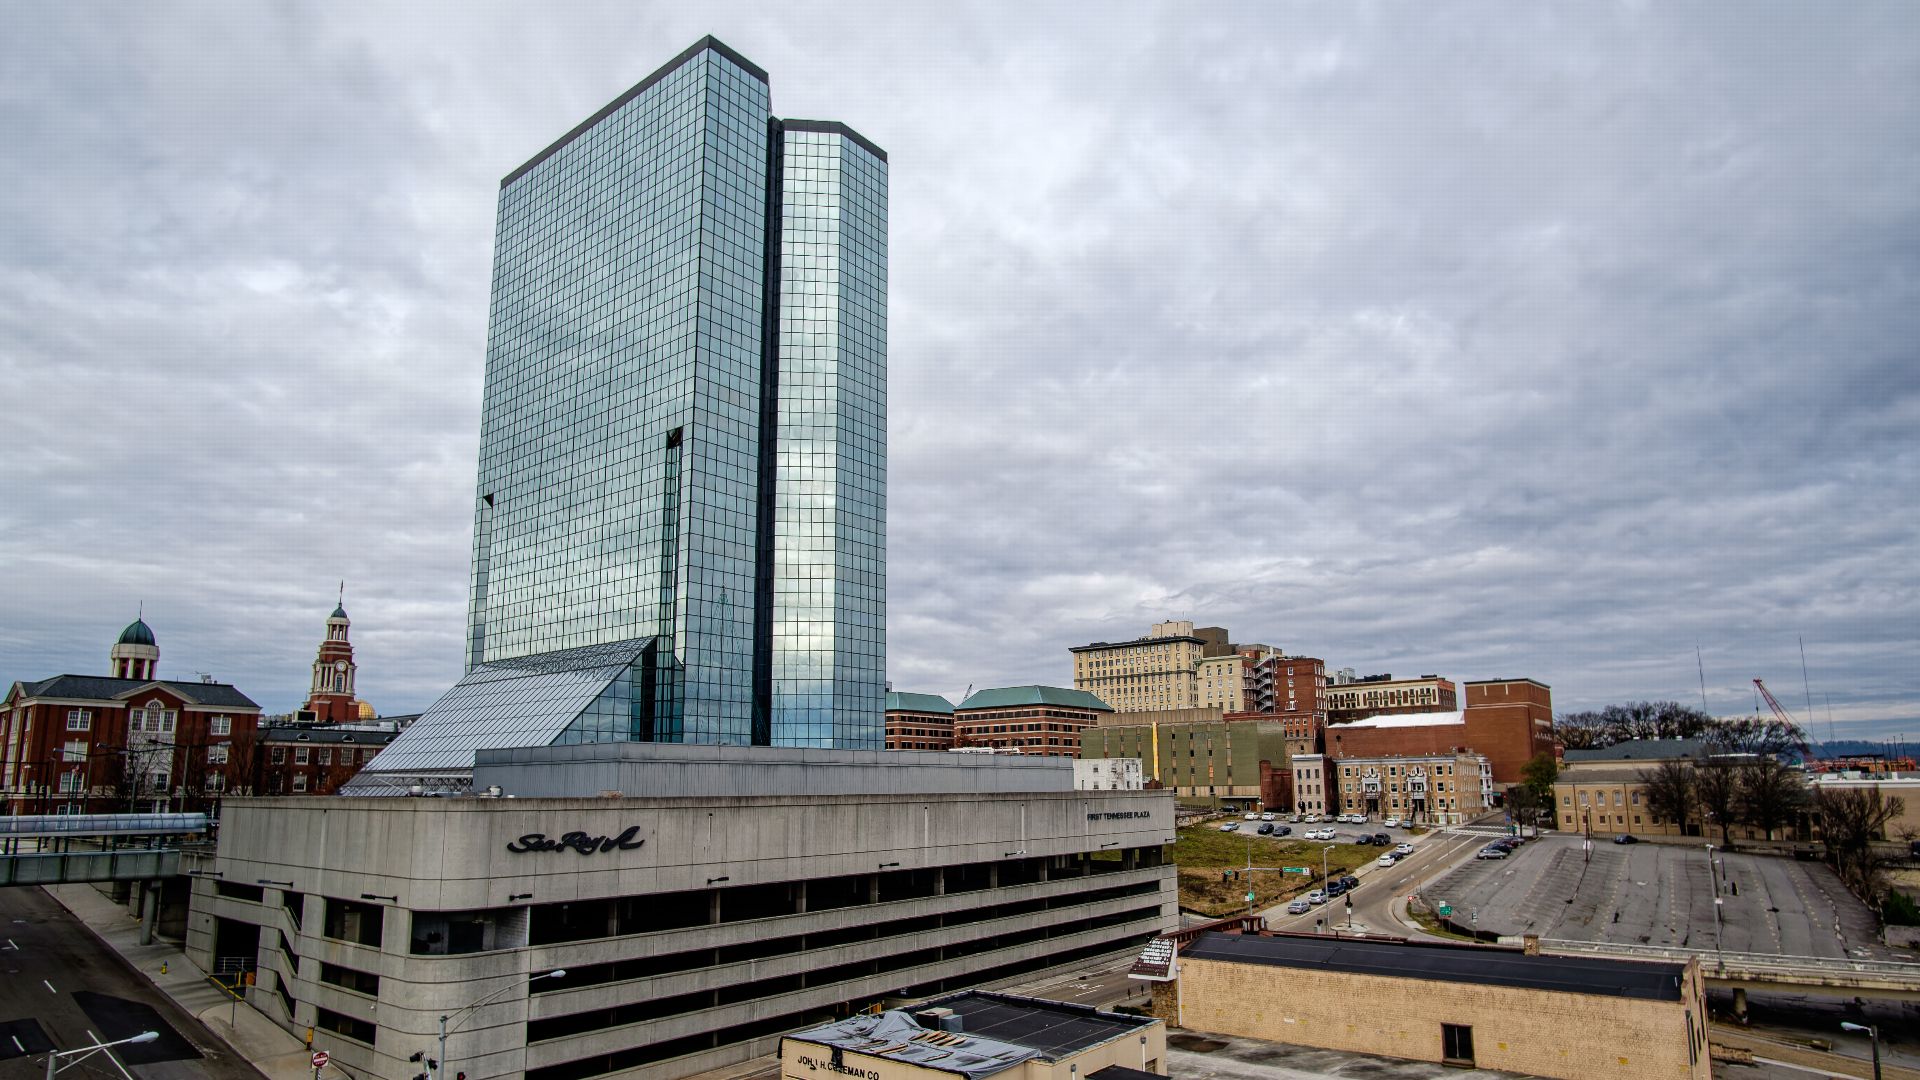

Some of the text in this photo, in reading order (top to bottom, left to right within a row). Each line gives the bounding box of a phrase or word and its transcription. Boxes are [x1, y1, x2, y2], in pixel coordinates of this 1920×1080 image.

[1087, 813, 1102, 821] FIRST
[1104, 812, 1133, 820] TENNESSEE
[828, 1062, 865, 1078] CEMAN
